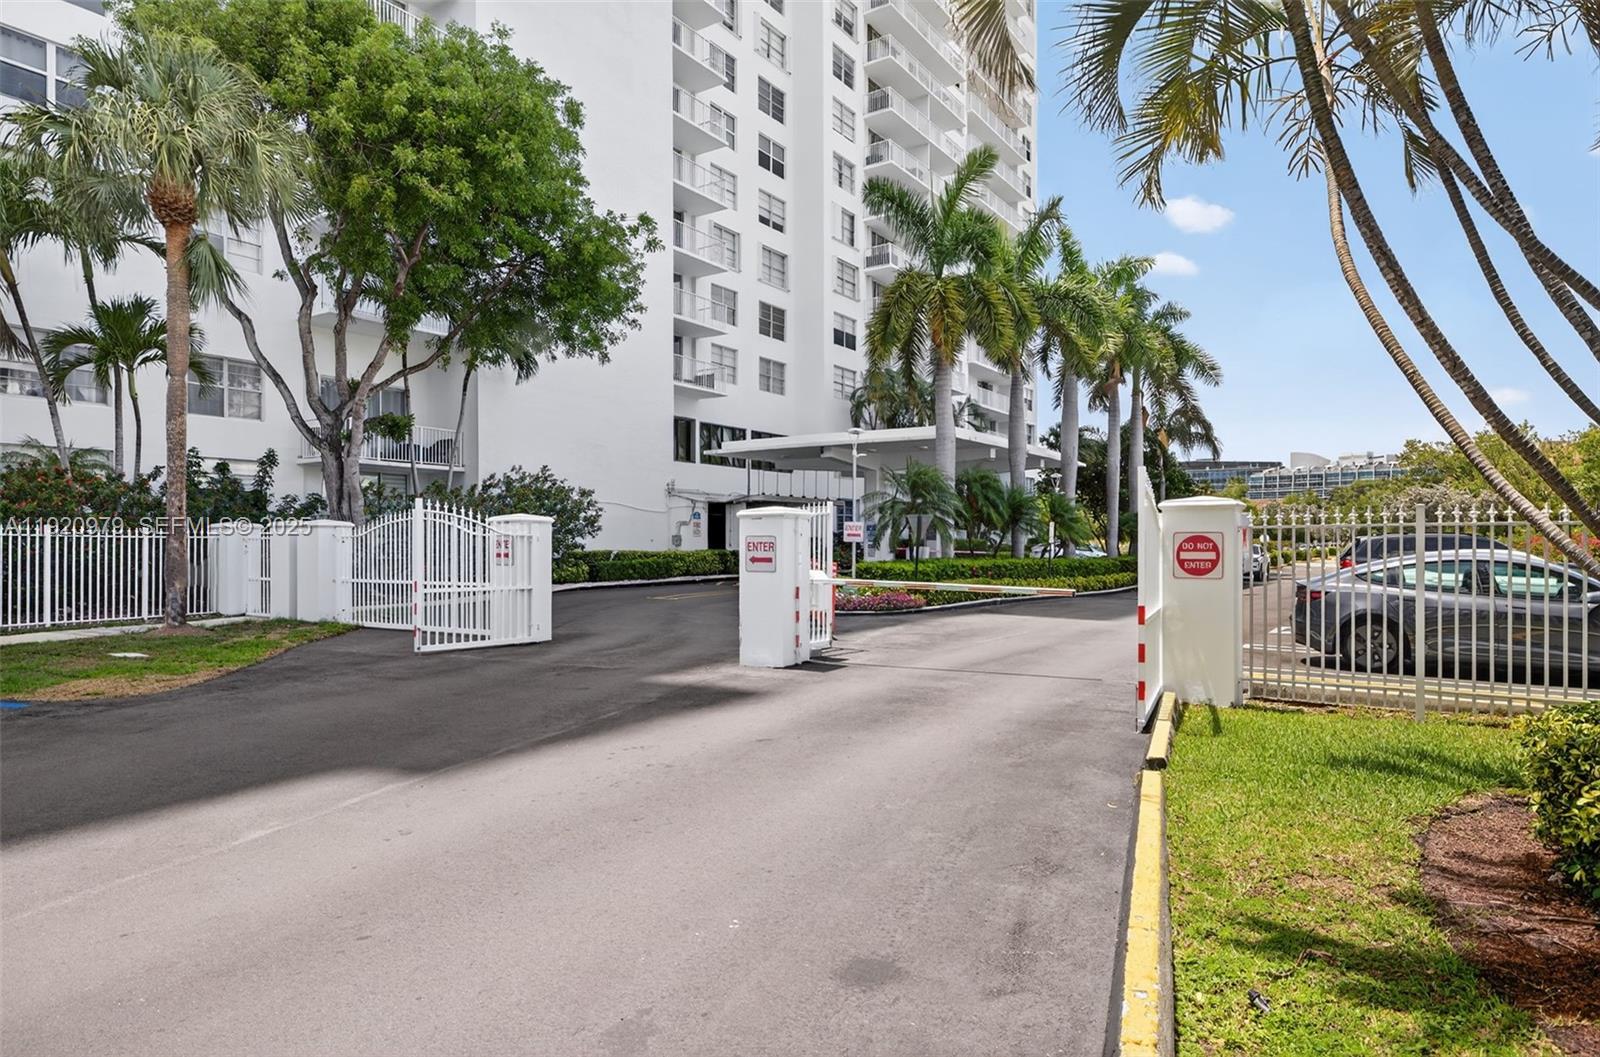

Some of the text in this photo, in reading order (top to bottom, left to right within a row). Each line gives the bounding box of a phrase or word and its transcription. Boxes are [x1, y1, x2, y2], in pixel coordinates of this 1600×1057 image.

[747, 541, 775, 552] ENTER
[1182, 542, 1214, 550] DO NOT
[1184, 561, 1212, 569] ENTER
